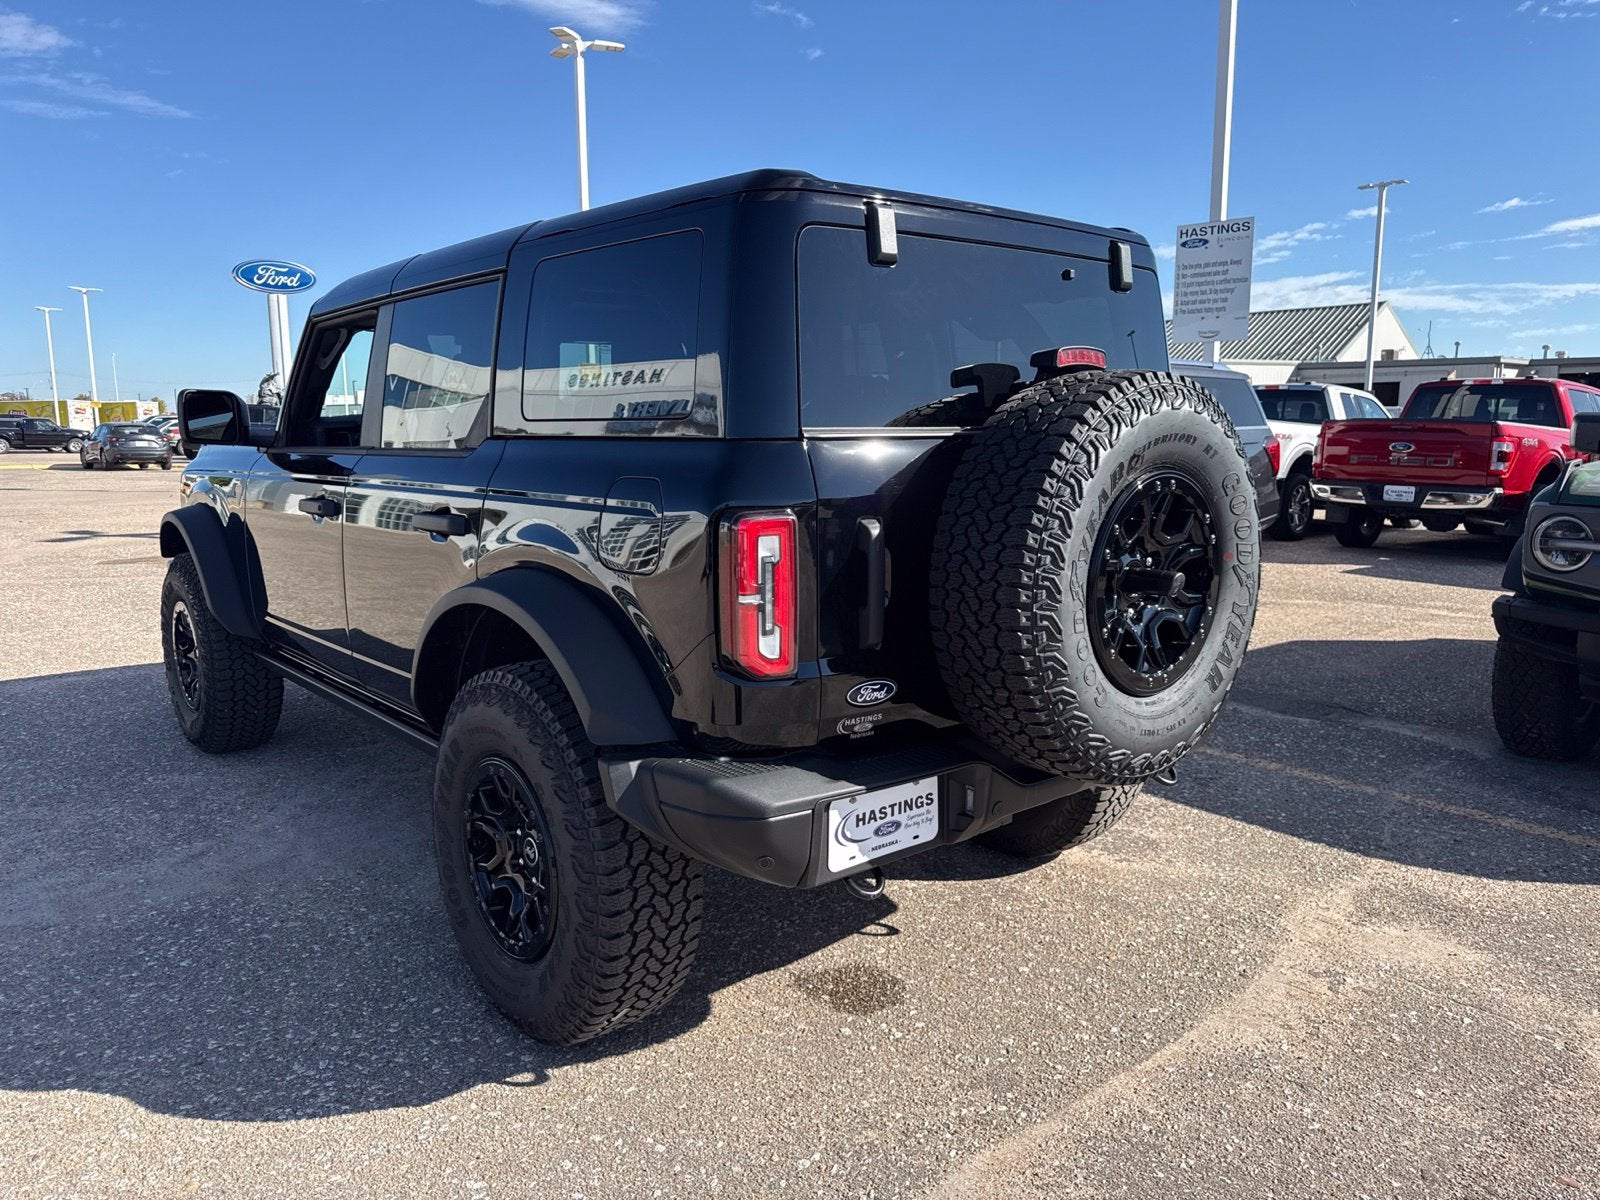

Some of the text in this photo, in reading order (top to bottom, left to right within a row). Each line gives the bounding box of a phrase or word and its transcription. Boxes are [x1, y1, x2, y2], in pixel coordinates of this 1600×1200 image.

[1180, 221, 1251, 239] HASTINGS
[254, 265, 300, 287] Ford
[1141, 432, 1219, 459] TERRITORY RT
[1205, 472, 1253, 693] GOODYEAR
[857, 685, 888, 702] Ford
[845, 713, 883, 726] HASTINGS
[850, 730, 875, 739] Nebraska
[856, 793, 934, 828] HASTINGS
[871, 839, 899, 852] NEBRASKA
